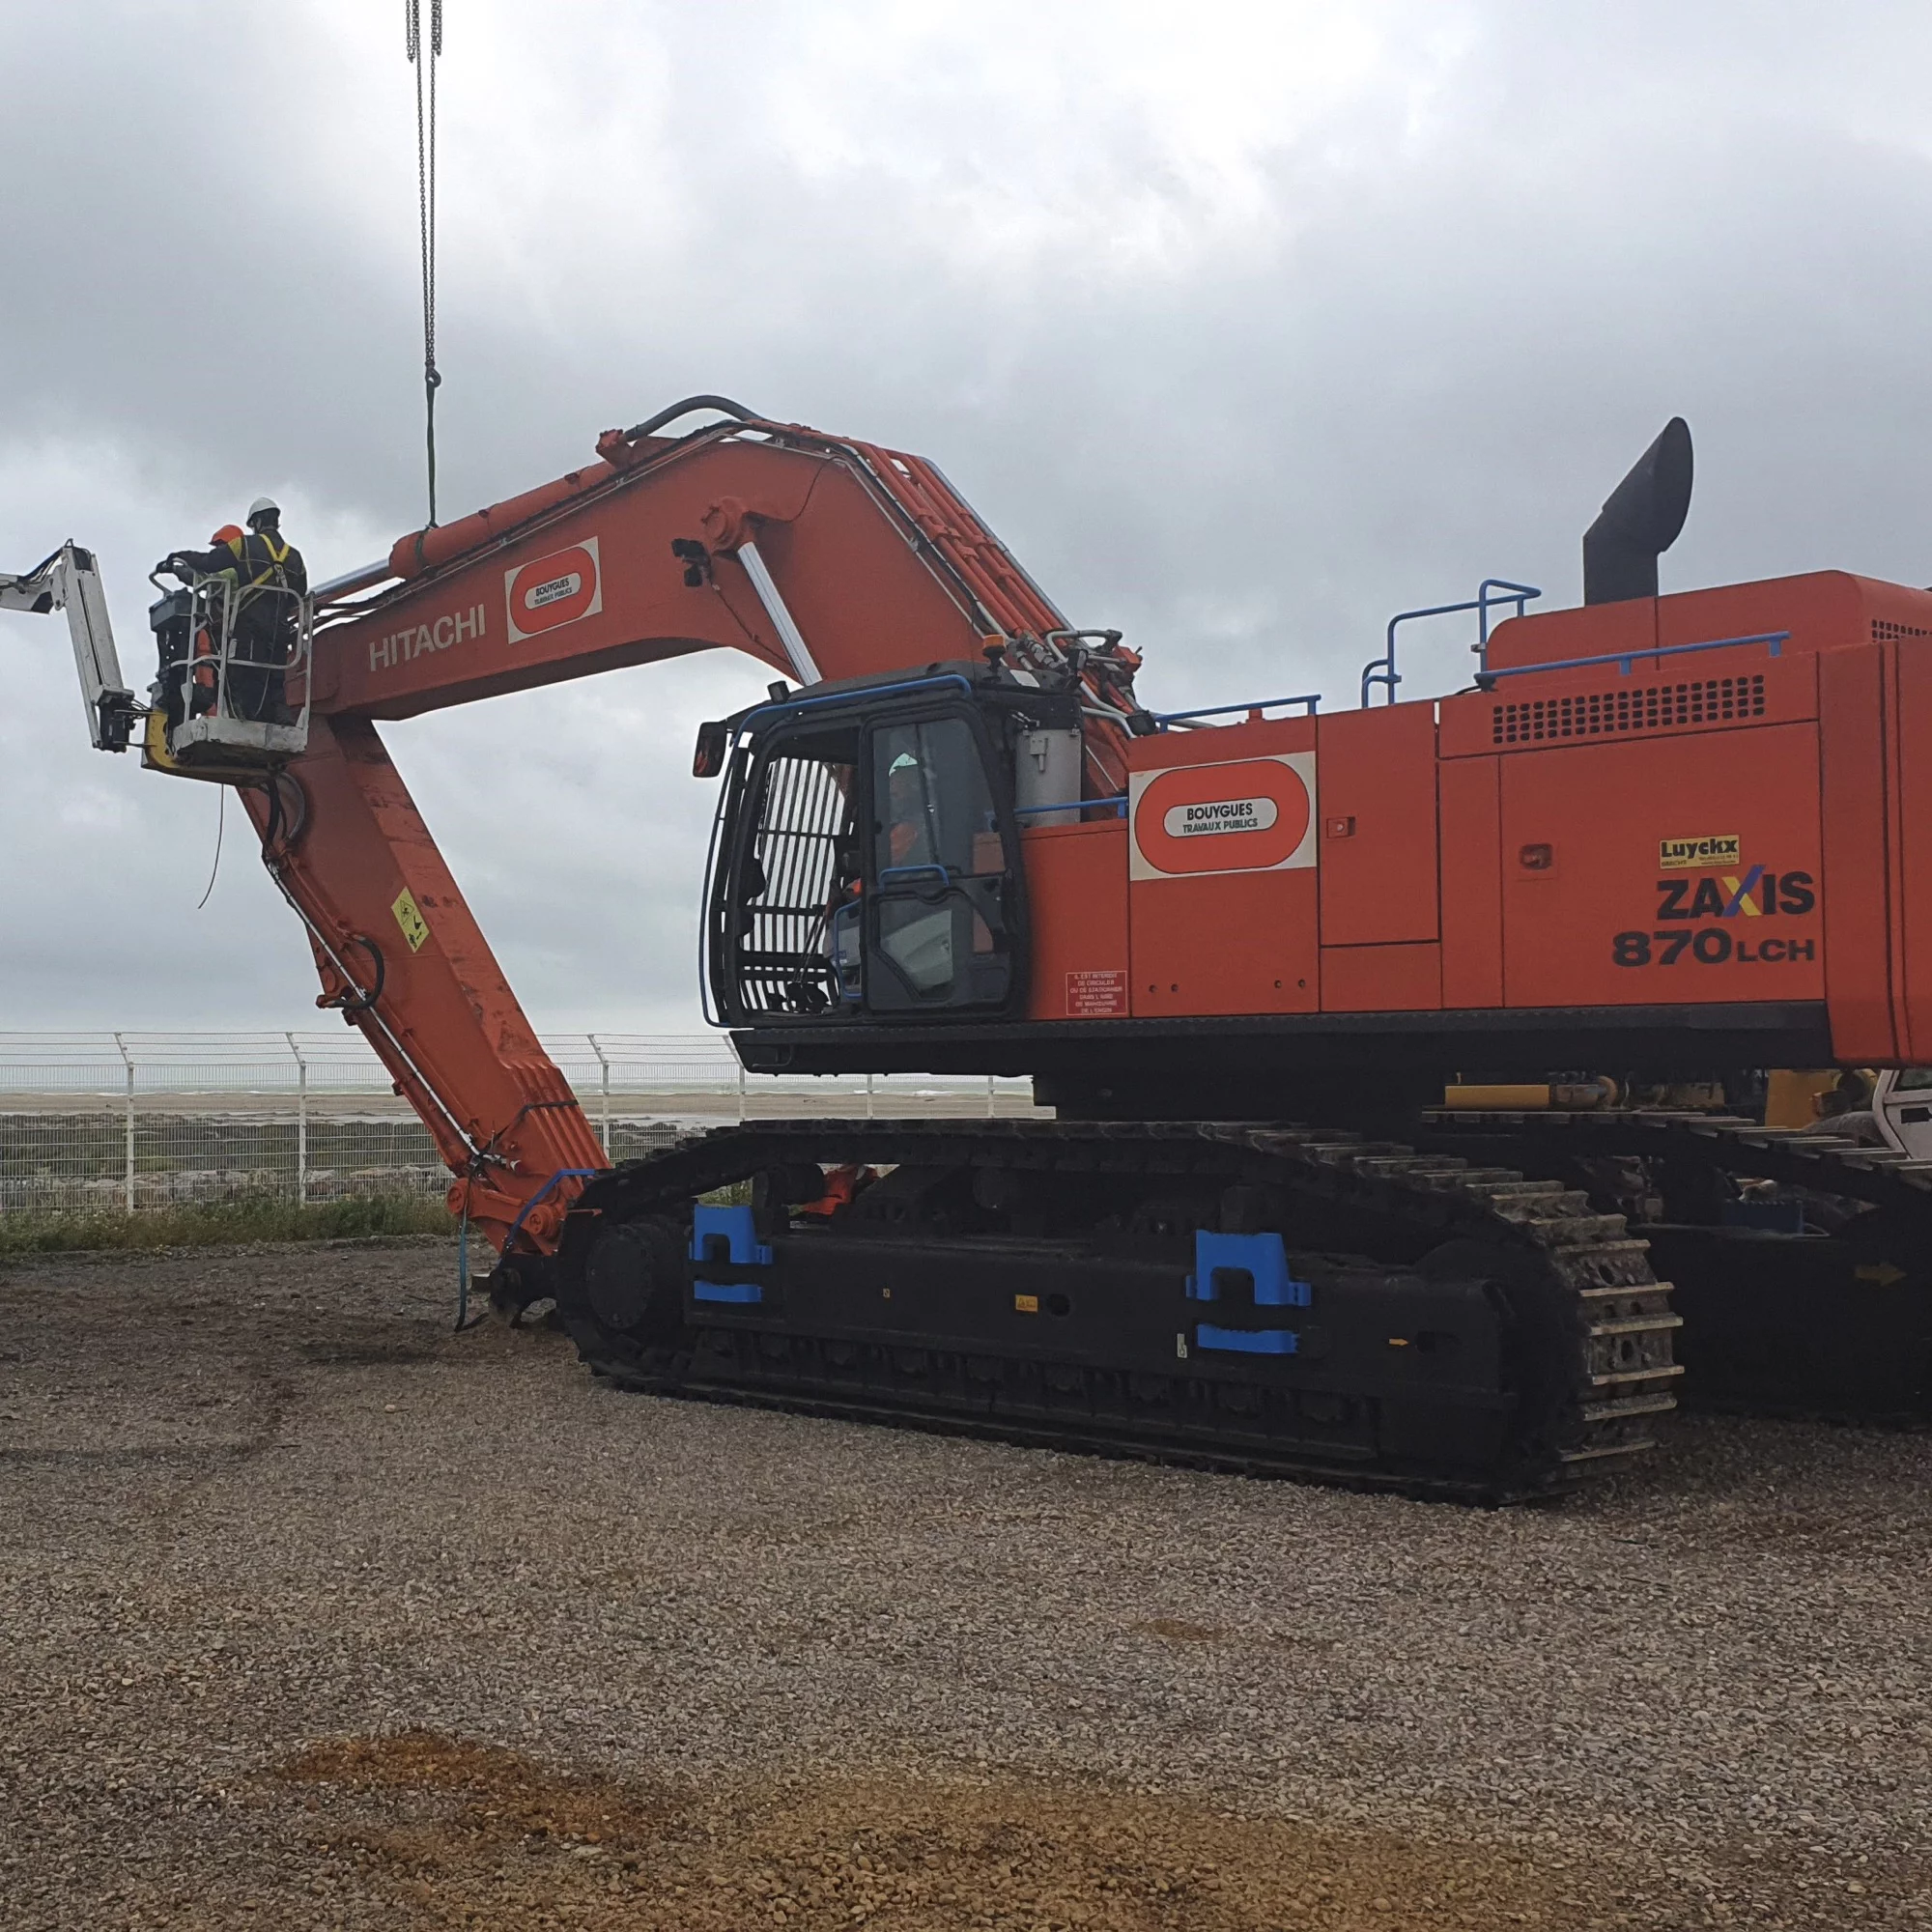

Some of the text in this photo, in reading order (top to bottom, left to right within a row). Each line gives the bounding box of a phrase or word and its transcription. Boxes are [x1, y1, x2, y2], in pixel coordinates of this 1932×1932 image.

[535, 578, 570, 597] BOUYGUES
[369, 604, 486, 671] HITACHI
[1187, 803, 1253, 821] BOUYGUES
[1182, 818, 1258, 834] TRAVAUX PUBLICS
[1661, 838, 1738, 859] Luyckx
[1657, 865, 1815, 920] ZAXIS
